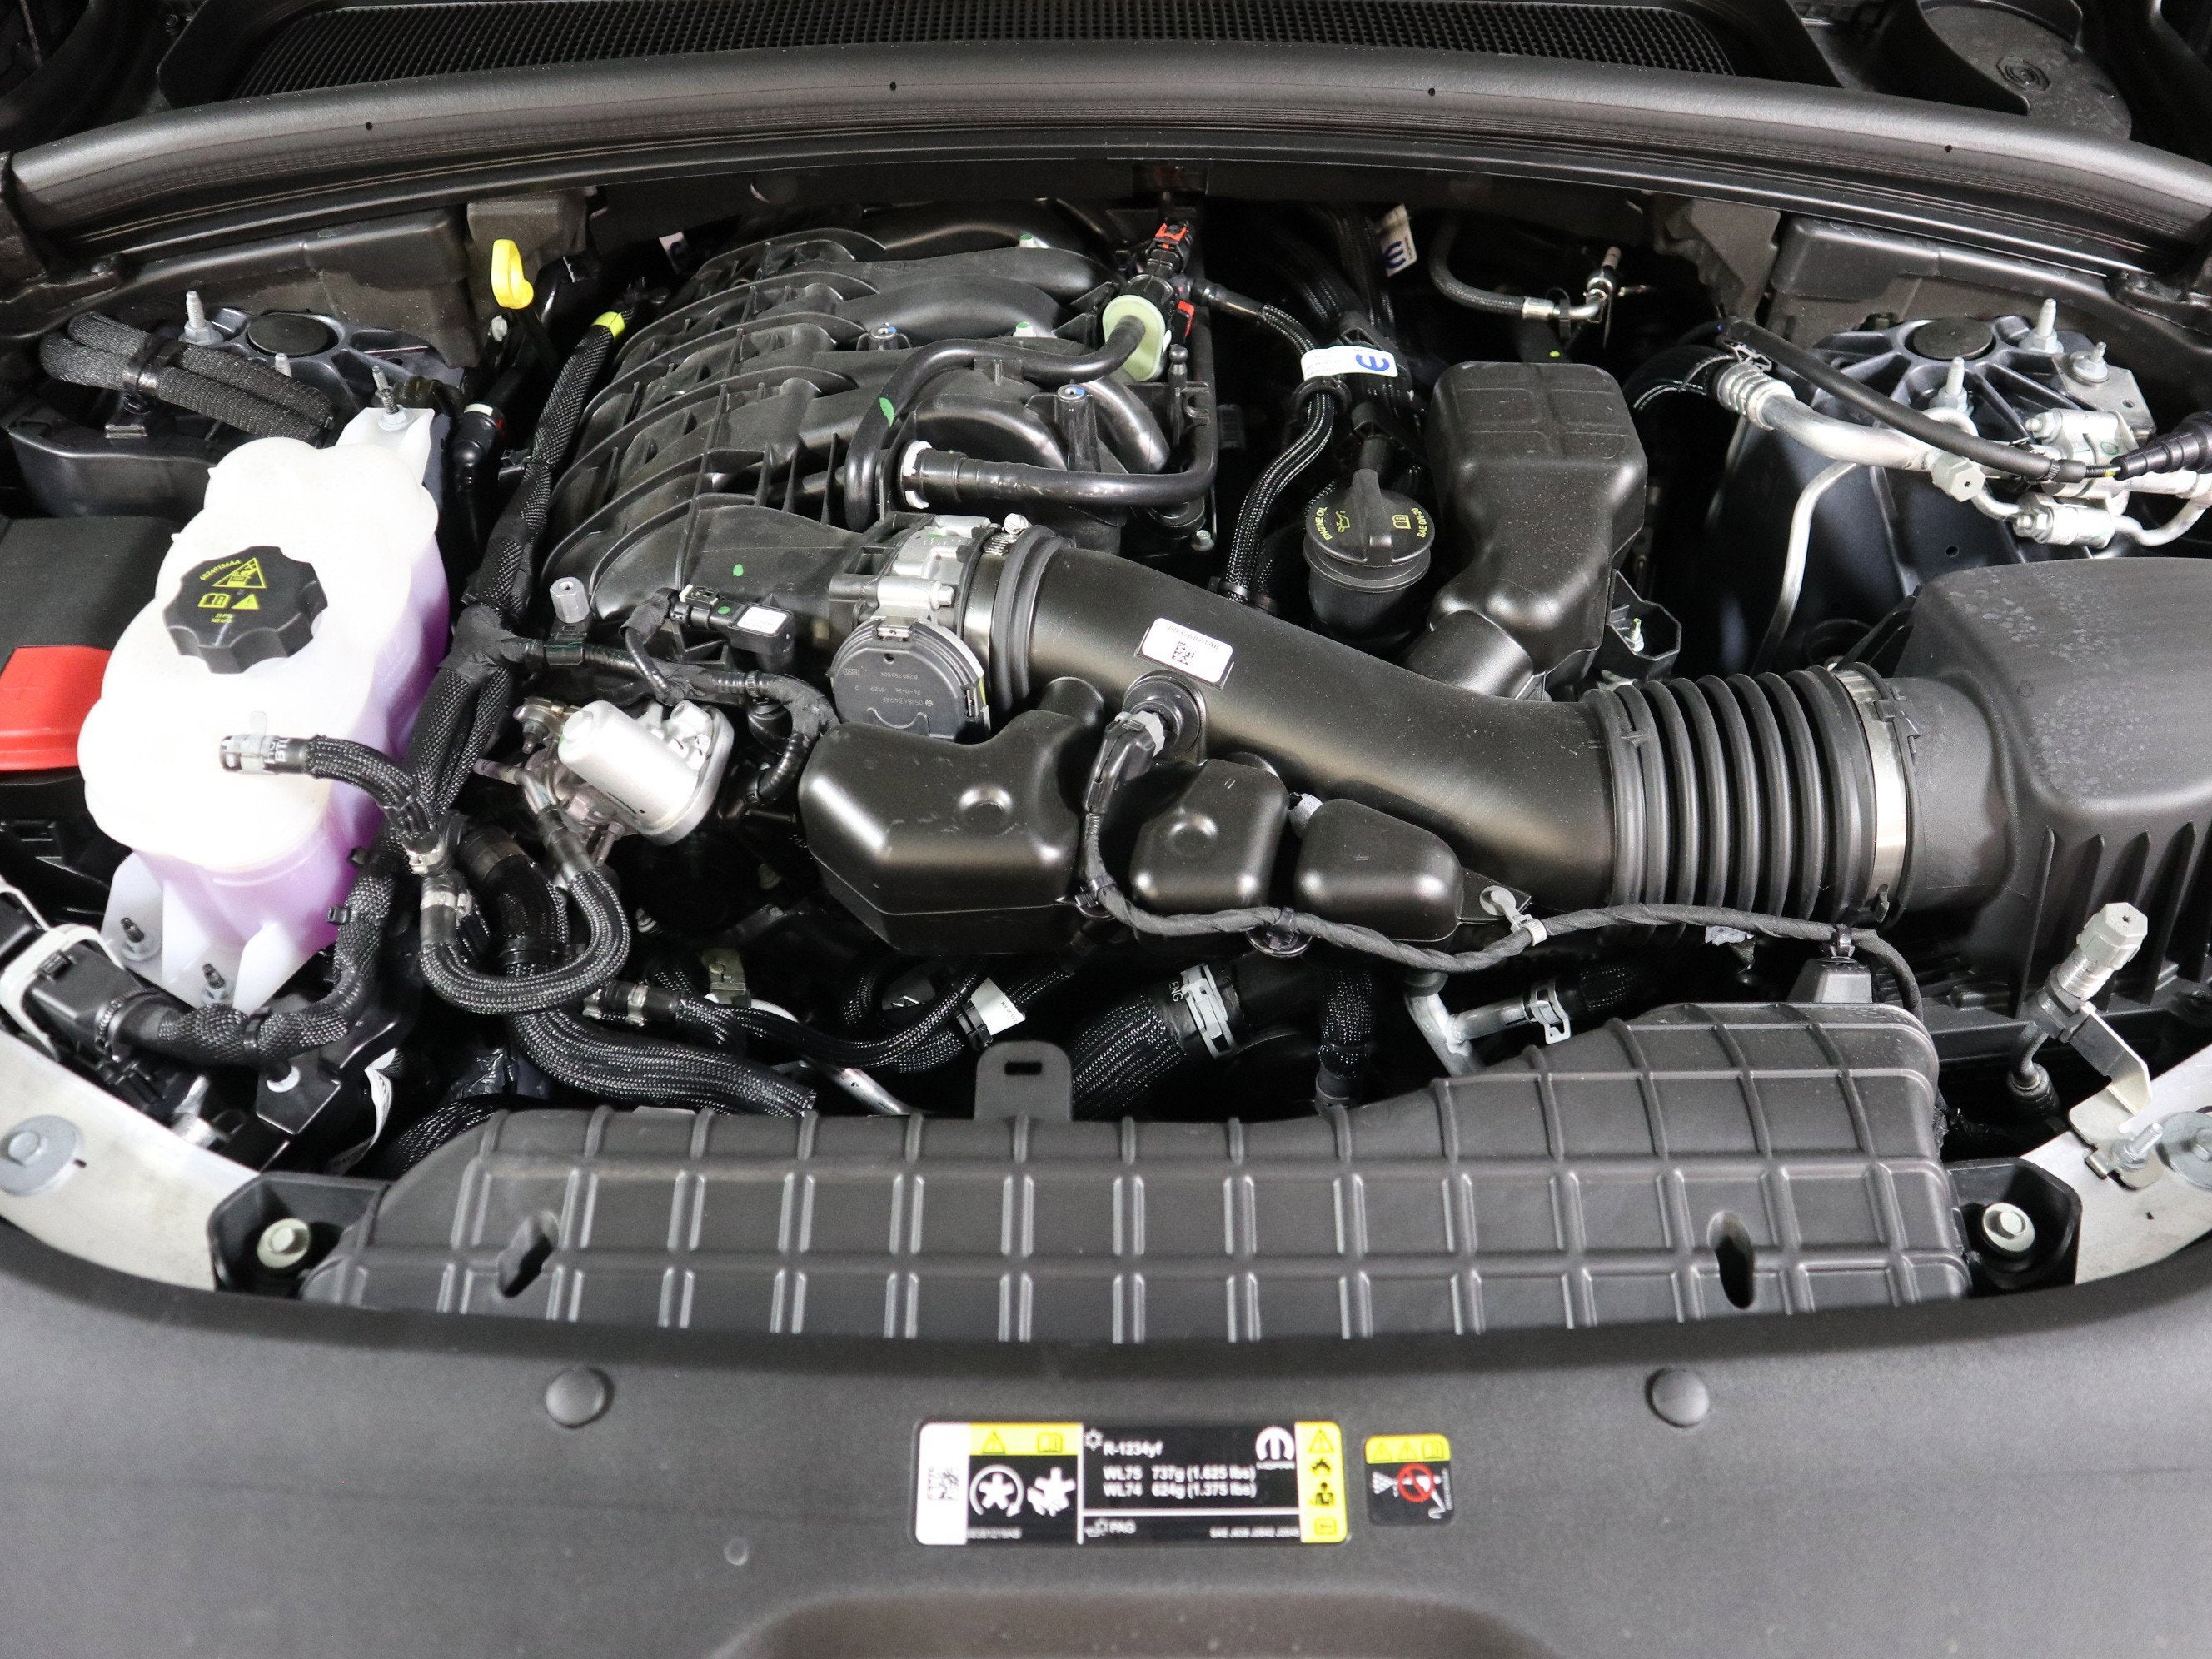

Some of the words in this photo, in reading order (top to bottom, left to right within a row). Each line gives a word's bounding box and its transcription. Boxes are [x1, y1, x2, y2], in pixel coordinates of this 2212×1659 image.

[1316, 506, 1328, 516] OIL
[1314, 516, 1333, 541] ENGINE
[1417, 525, 1427, 538] SAE
[1168, 981, 1184, 1002] ENG
[1103, 1439, 1163, 1458] R-1234yf
